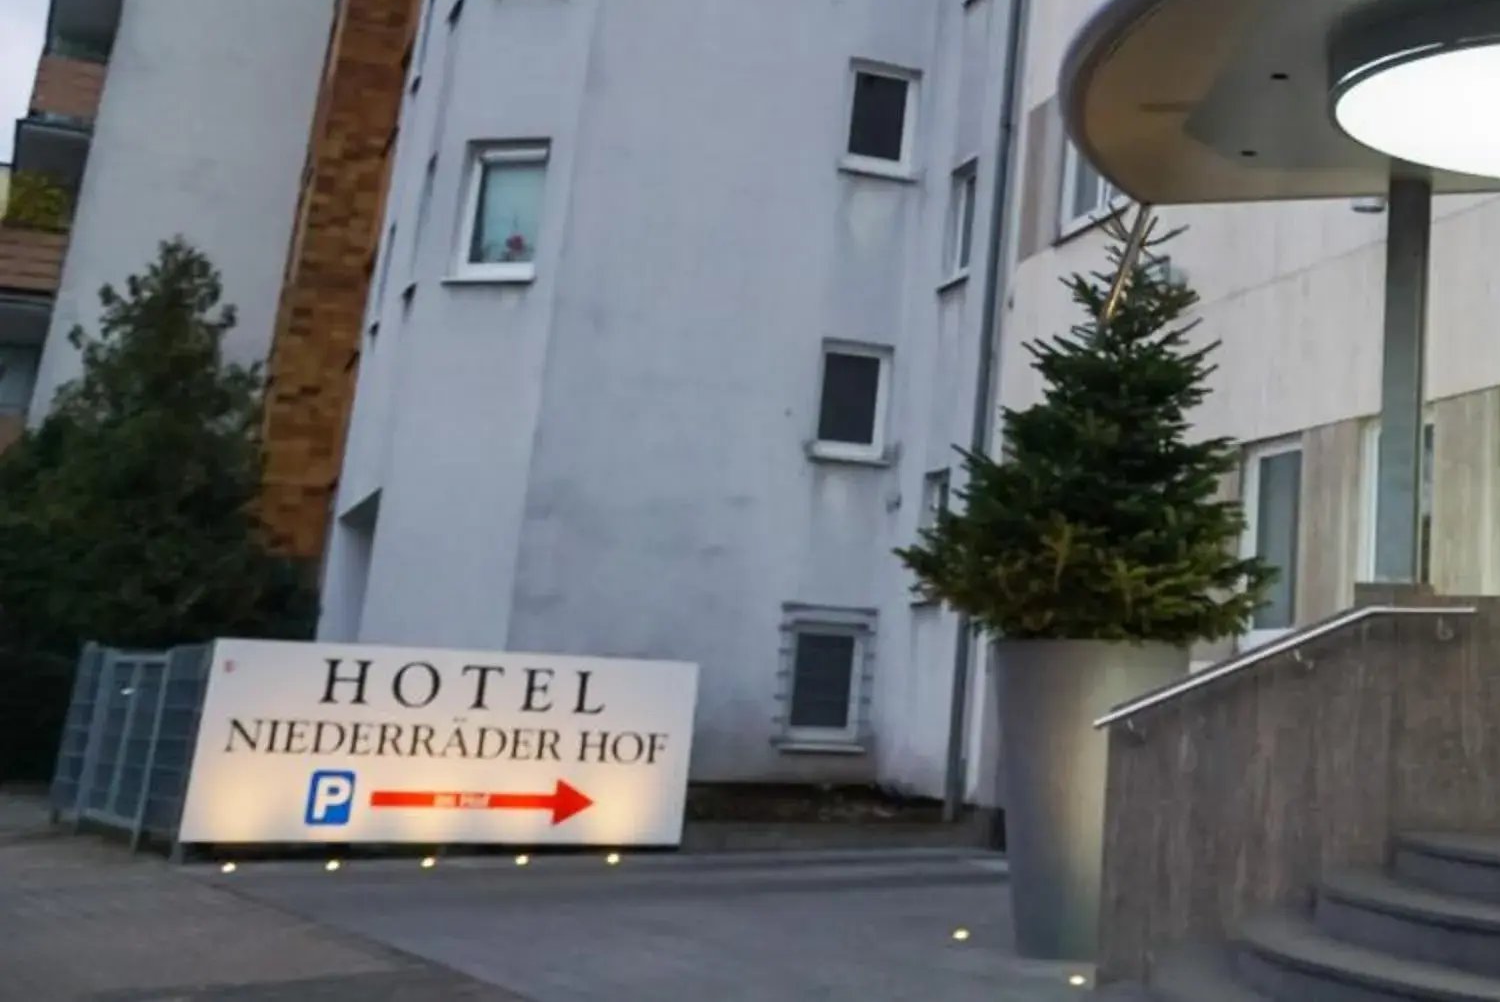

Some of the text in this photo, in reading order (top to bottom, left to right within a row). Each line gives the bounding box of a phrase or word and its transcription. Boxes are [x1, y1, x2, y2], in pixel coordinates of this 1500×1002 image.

[317, 658, 605, 716] HOTEL
[224, 715, 669, 765] NIEDERRÄDER HOF
[311, 776, 351, 821] P
